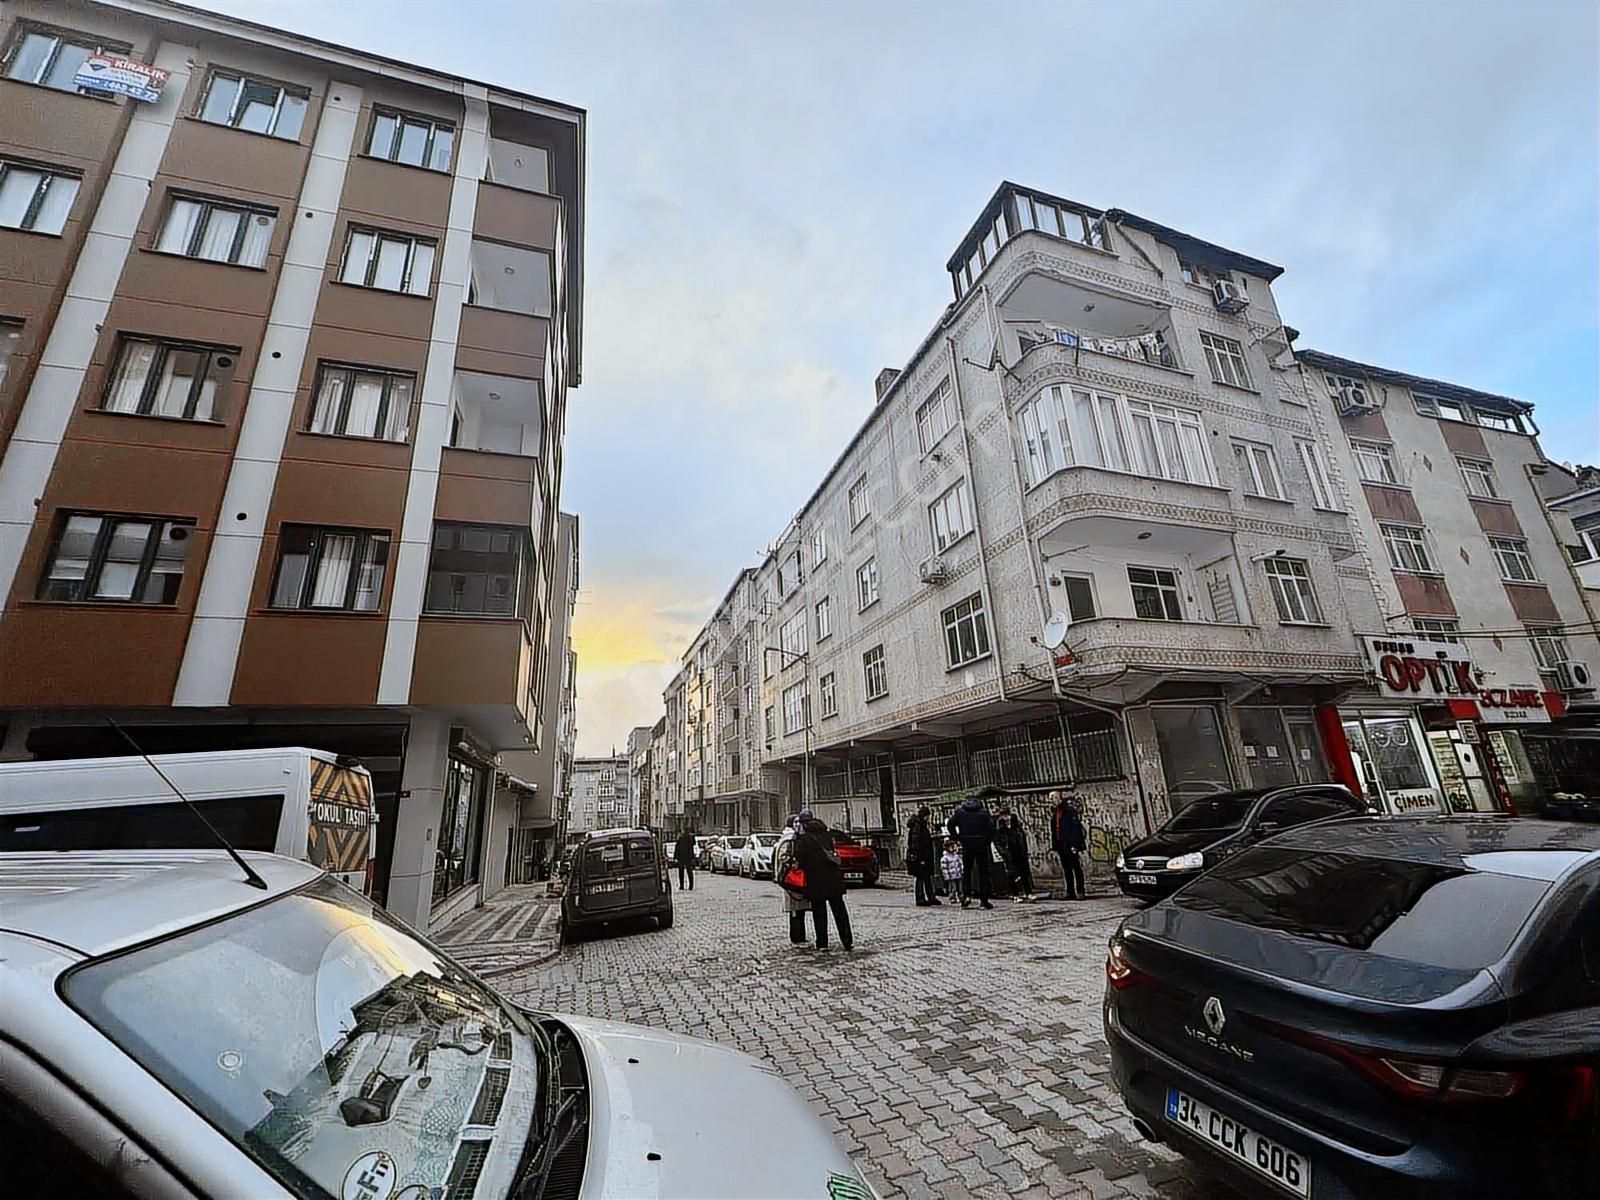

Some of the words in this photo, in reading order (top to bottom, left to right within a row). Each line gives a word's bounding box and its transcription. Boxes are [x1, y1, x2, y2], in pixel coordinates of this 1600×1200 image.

[1380, 650, 1480, 694] OPTİK
[317, 803, 341, 823] OKUL
[1394, 793, 1436, 812] ÇİMEN
[1184, 1025, 1254, 1063] MEGANE
[1178, 1094, 1201, 1130] 34
[1209, 1110, 1248, 1159] CCK
[1256, 1136, 1300, 1187] 606
